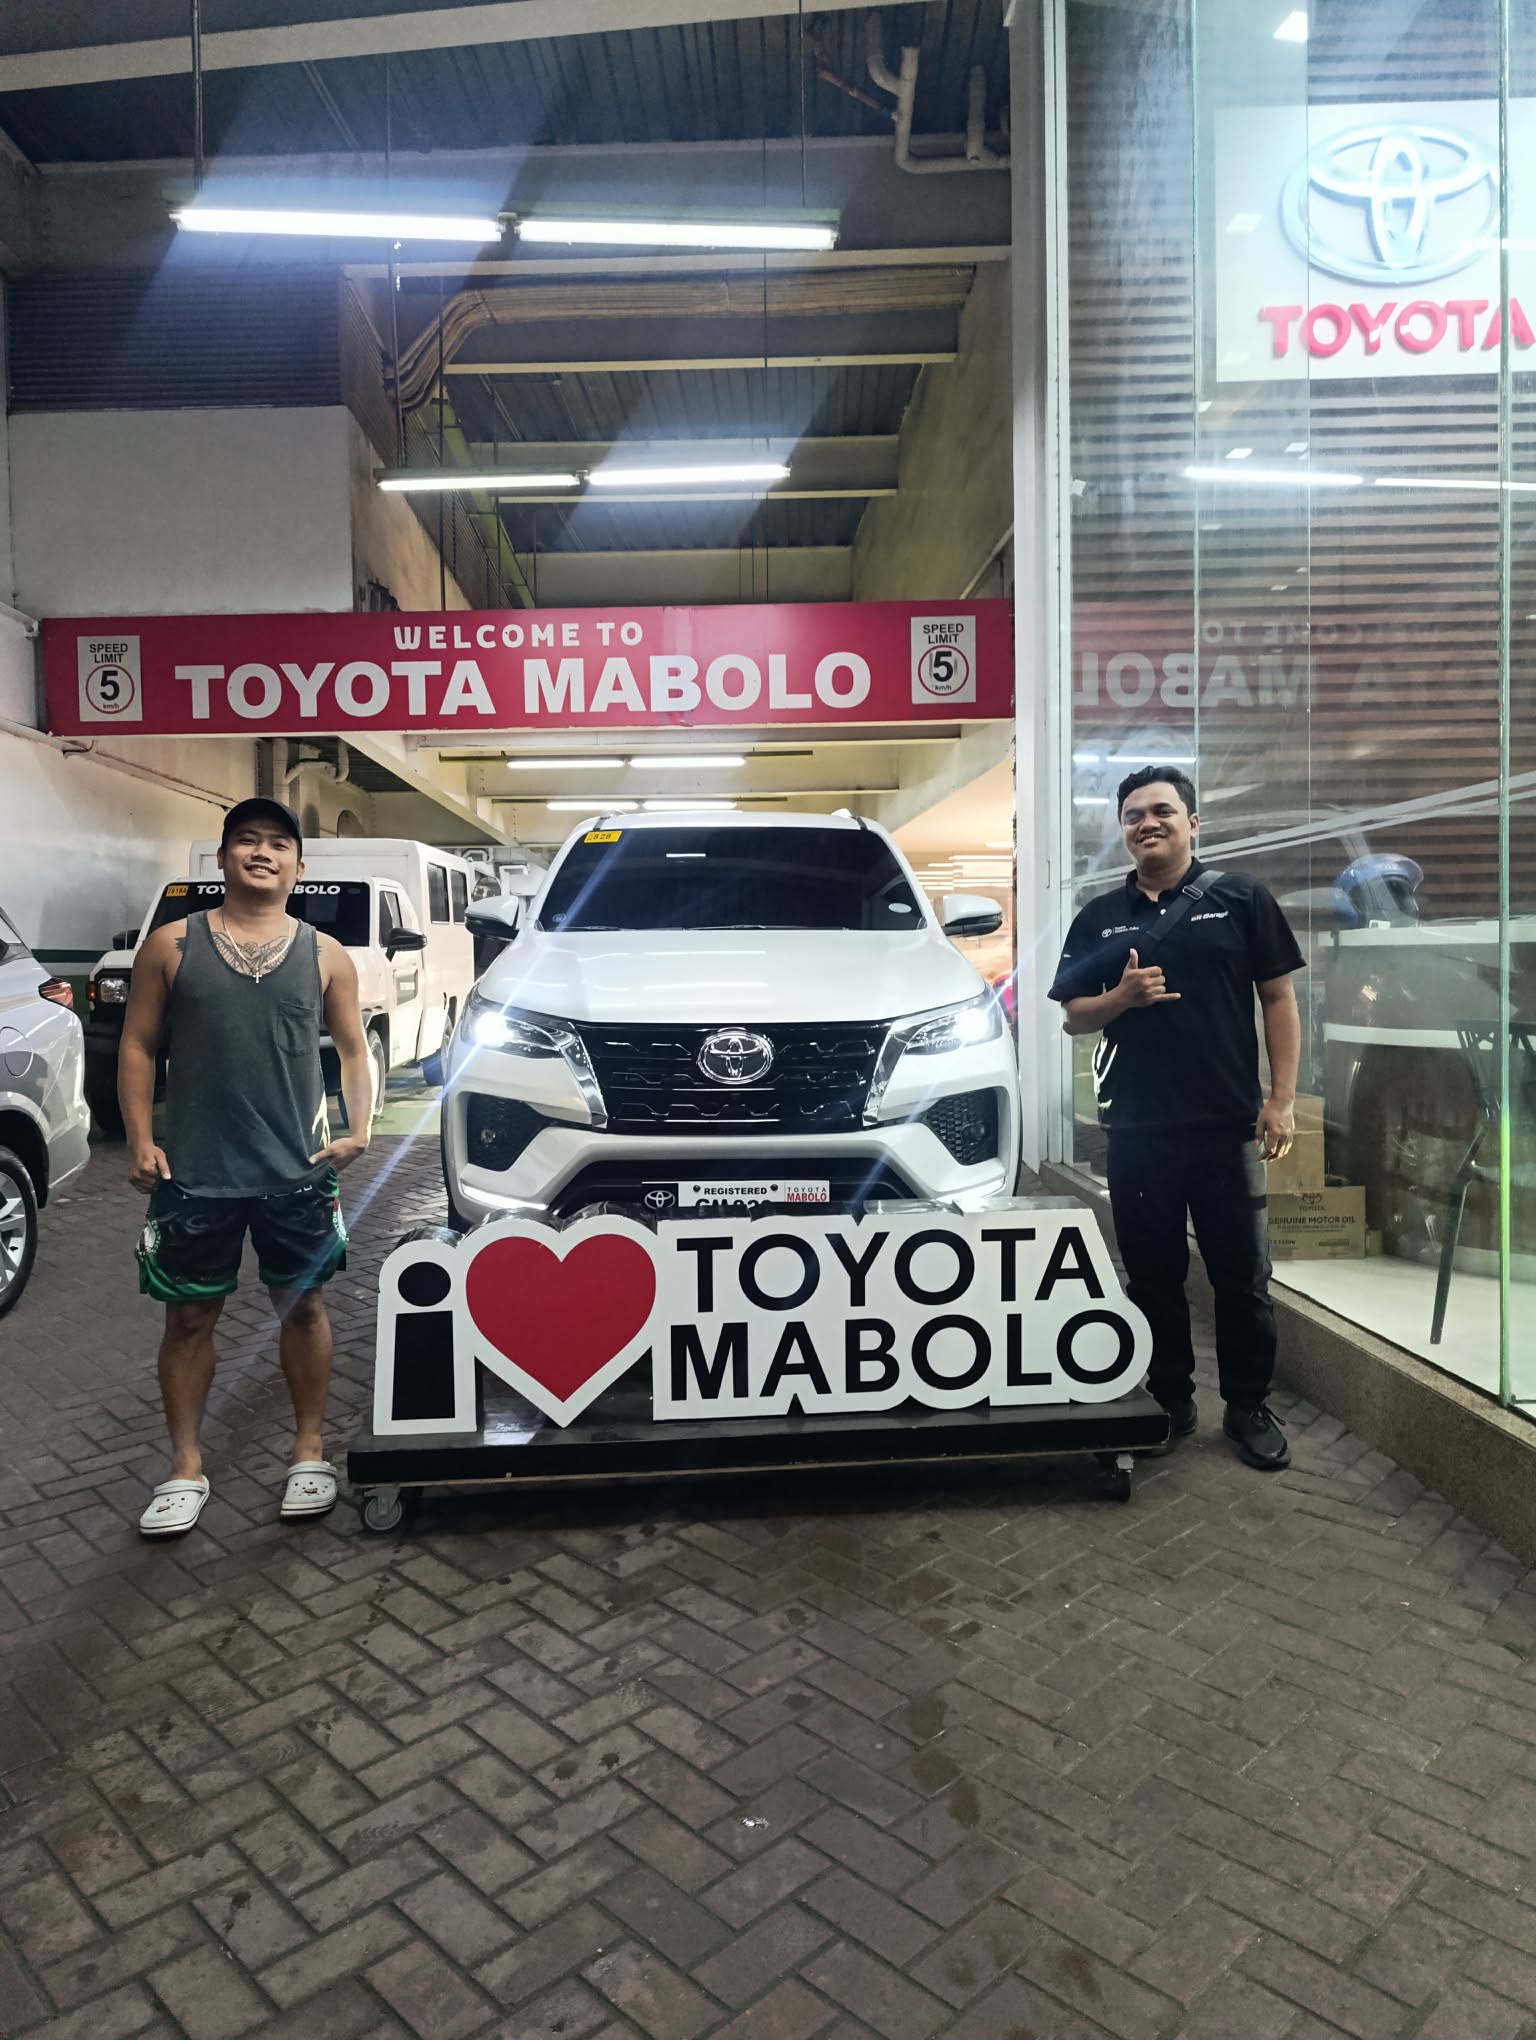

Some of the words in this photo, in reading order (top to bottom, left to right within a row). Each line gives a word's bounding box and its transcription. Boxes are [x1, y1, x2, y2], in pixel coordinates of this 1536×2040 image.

[1258, 297, 1536, 357] TOYOTA
[922, 623, 964, 634] SPEED
[394, 622, 580, 650] WELCOME
[596, 621, 643, 646] TO
[927, 634, 960, 644] LIMIT
[89, 643, 128, 653] SPEED
[94, 653, 124, 663] LIMIT
[932, 650, 954, 682] 5
[100, 670, 120, 701] 5
[175, 660, 497, 719] TOYOTA
[523, 652, 872, 713] MABOLO
[197, 885, 226, 895] TOY
[291, 884, 341, 895] BOLO
[704, 1187, 767, 1196] REGISTERED
[786, 1193, 827, 1202] MABOLO
[1308, 1216, 1340, 1225] MOTOR
[676, 1226, 1106, 1313] TOYOTA
[670, 1309, 1135, 1402] MABOLO
